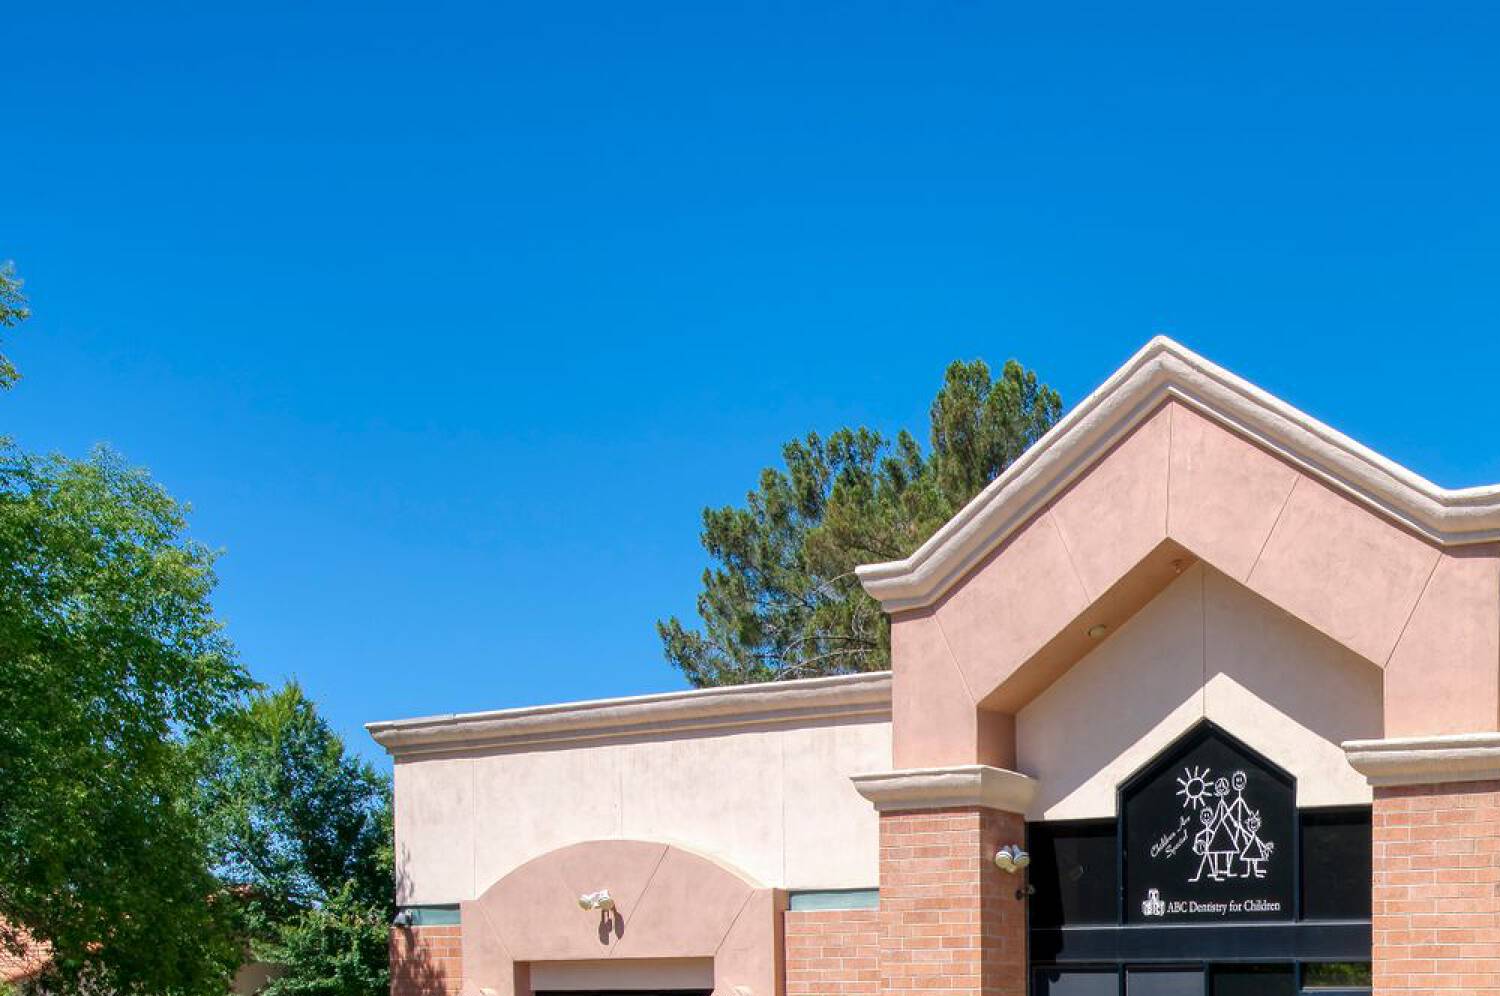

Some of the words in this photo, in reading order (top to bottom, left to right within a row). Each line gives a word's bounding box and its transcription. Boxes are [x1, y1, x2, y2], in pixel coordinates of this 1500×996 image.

[1167, 901, 1188, 913] ABC
[1189, 901, 1227, 915] Dentistry
[1229, 900, 1242, 912] for
[1244, 899, 1280, 912] Children
